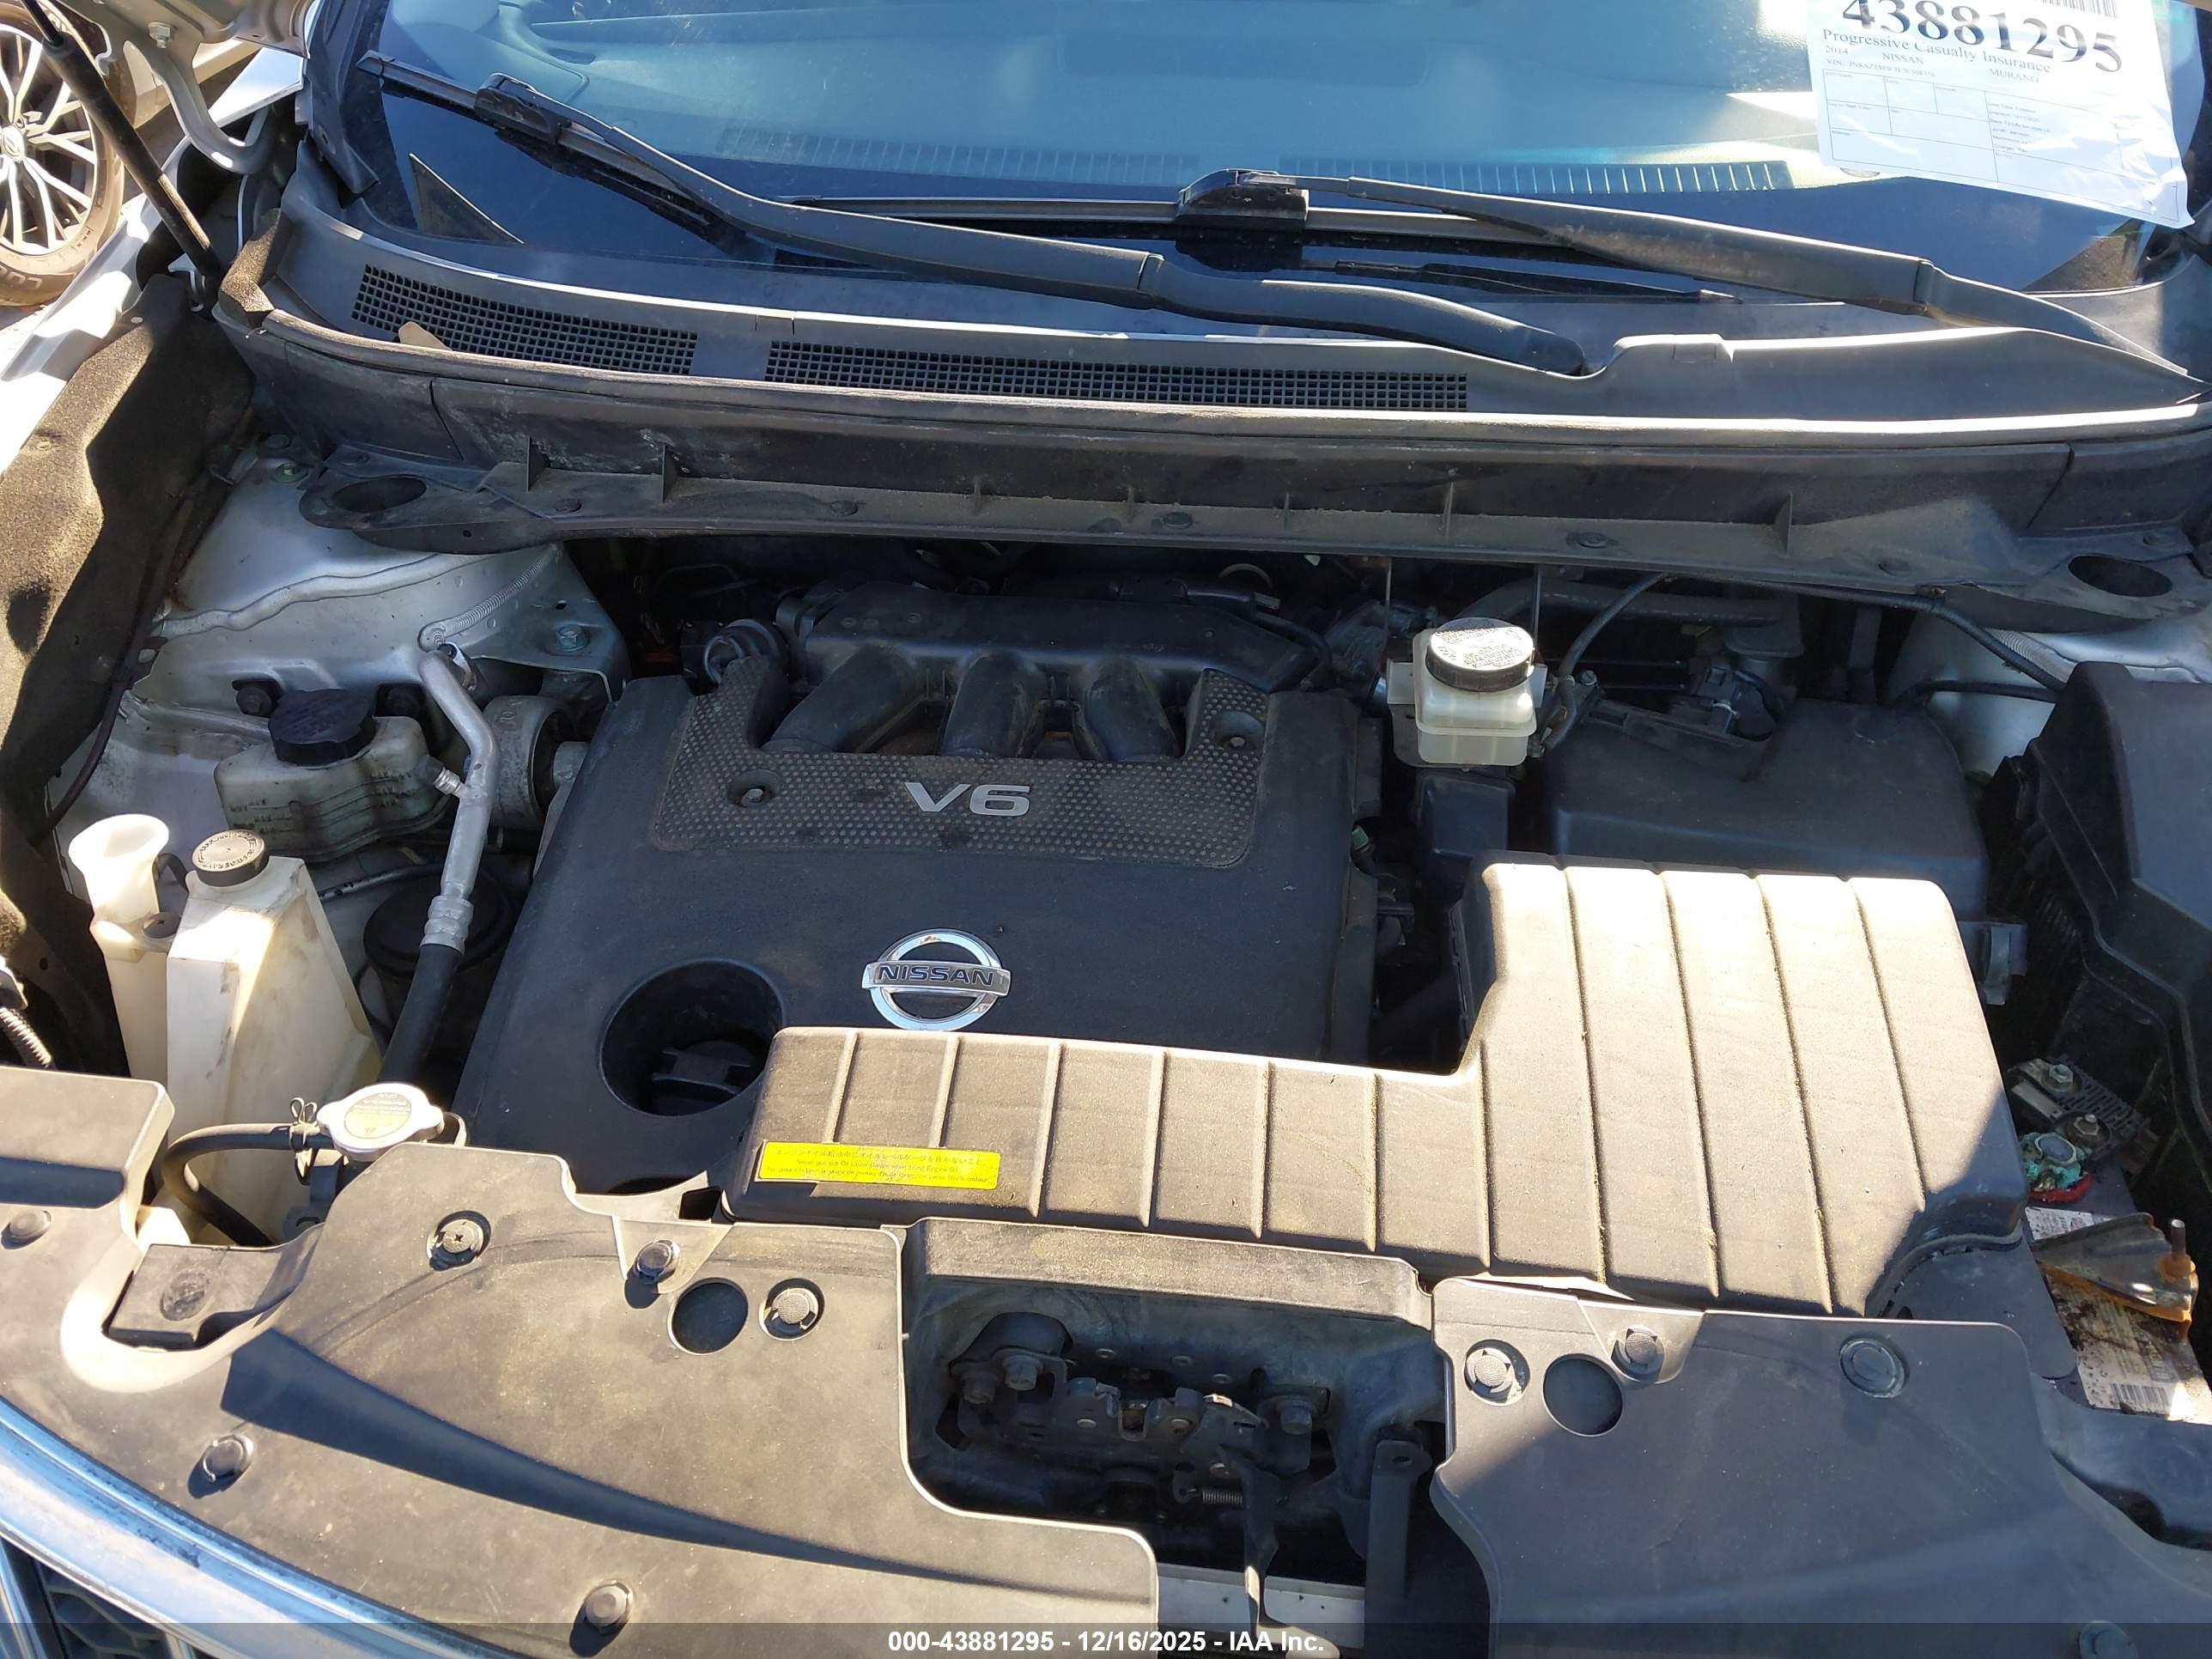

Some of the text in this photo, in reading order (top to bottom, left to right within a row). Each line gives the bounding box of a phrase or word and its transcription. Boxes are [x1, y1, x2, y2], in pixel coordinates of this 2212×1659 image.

[1822, 28, 2051, 74] Progressive Casualty Insurance
[1843, 0, 2123, 72] 43881295
[1881, 52, 1924, 65] NISSAN
[1988, 67, 2040, 83] MURANO
[905, 781, 1030, 817] V6
[878, 963, 994, 987] NISSAN
